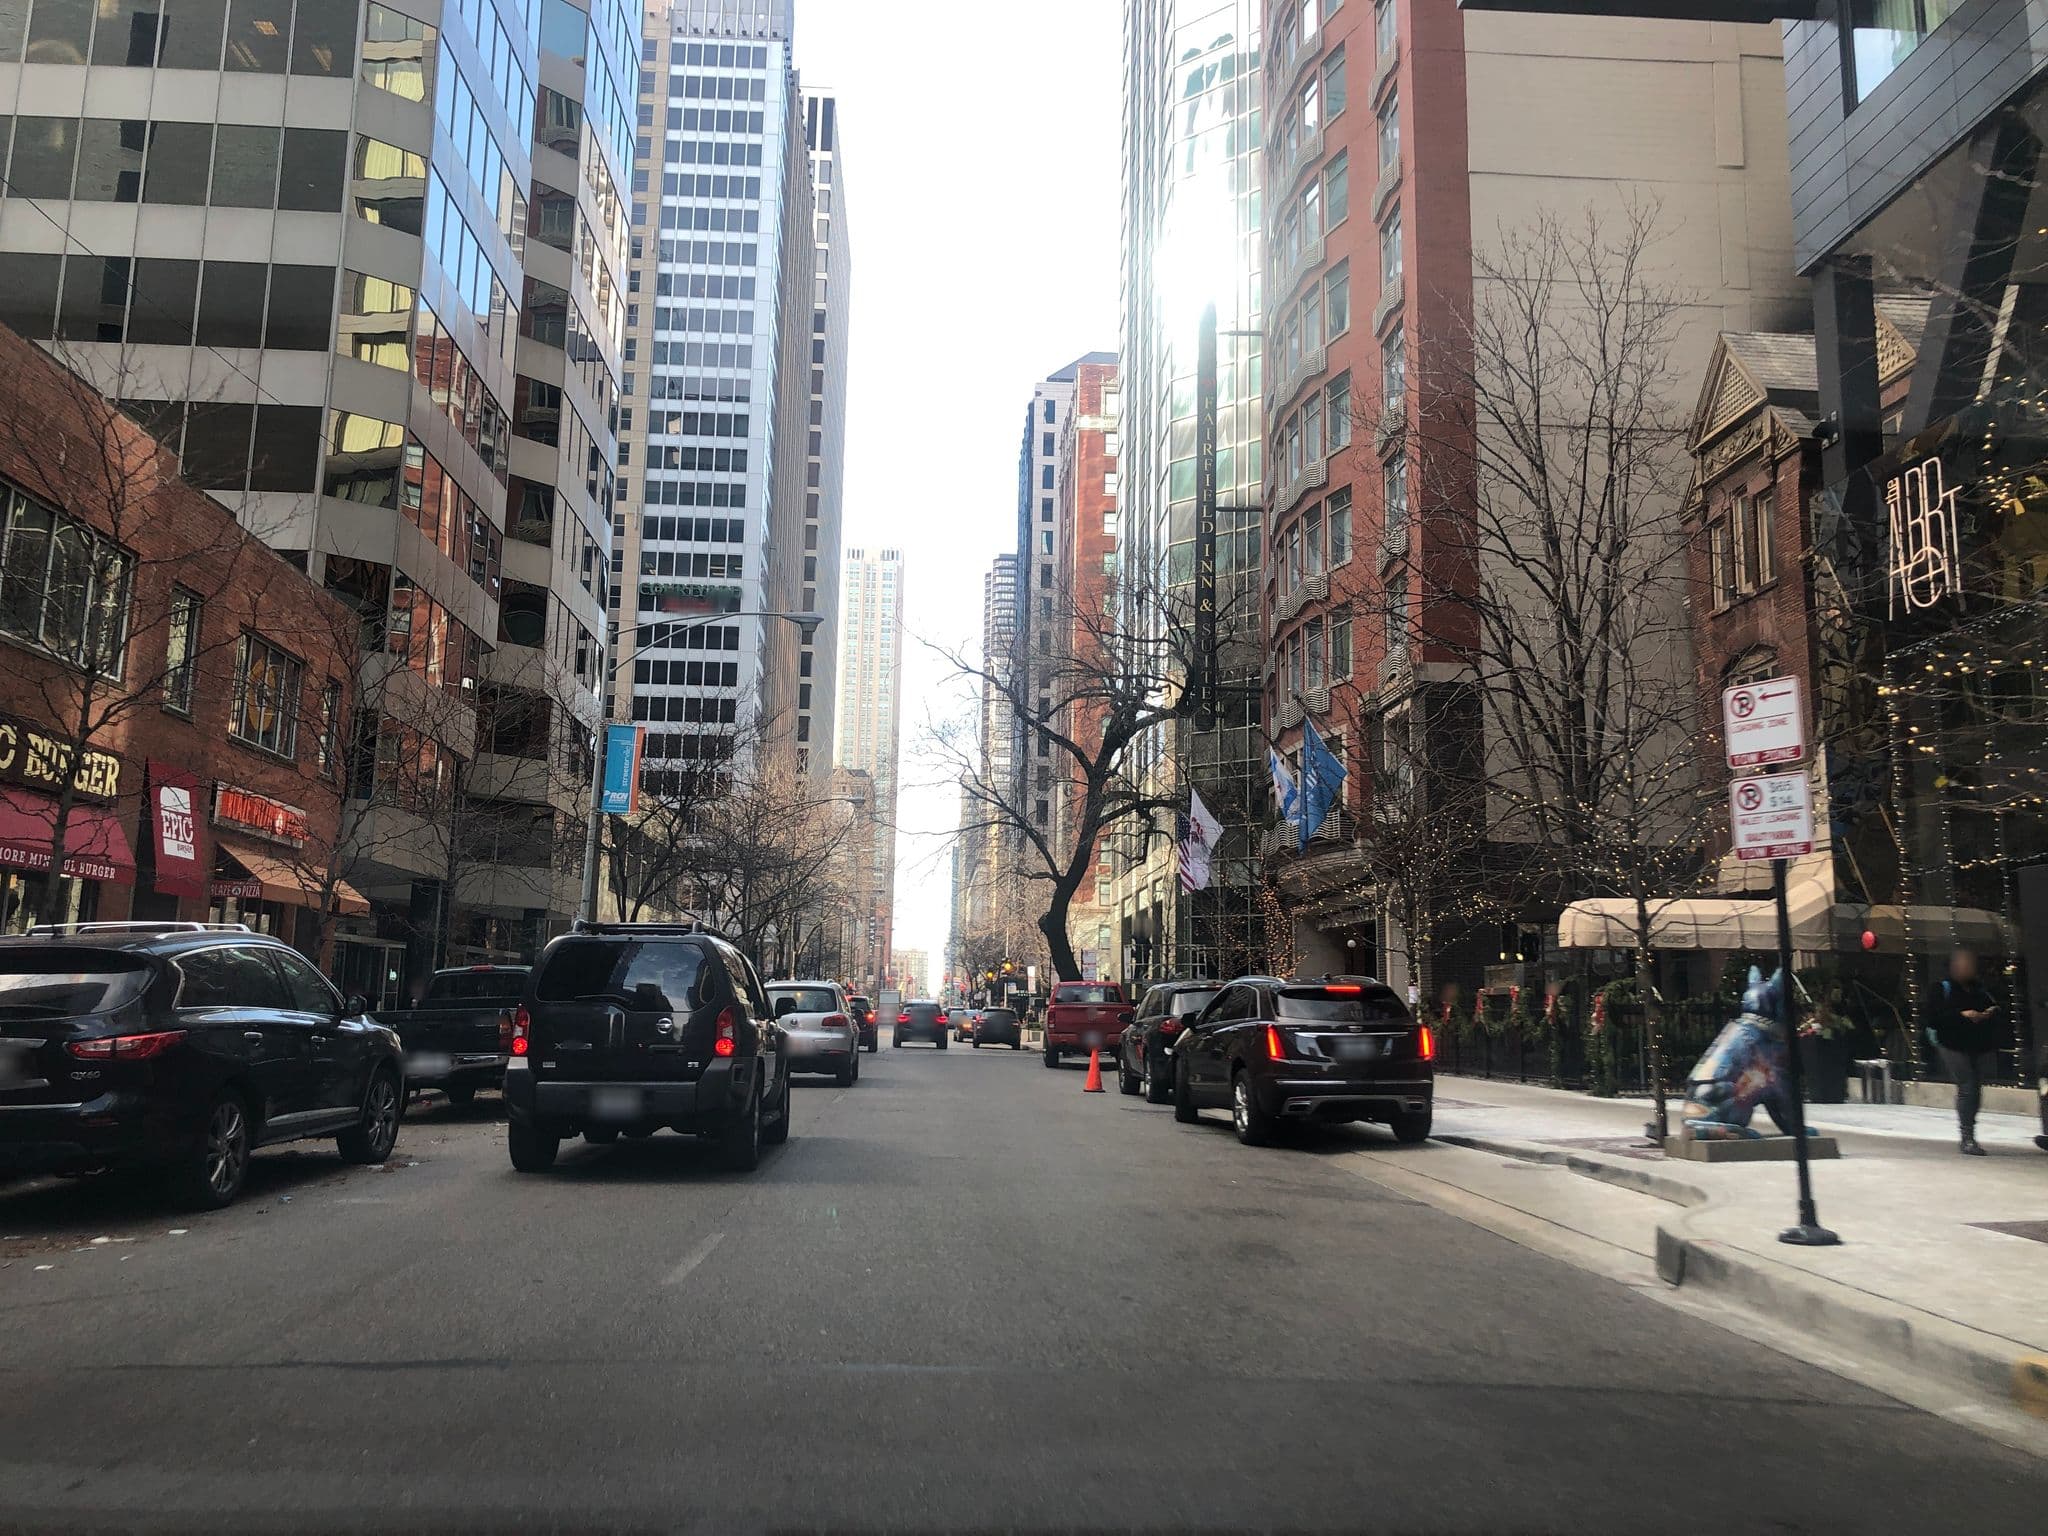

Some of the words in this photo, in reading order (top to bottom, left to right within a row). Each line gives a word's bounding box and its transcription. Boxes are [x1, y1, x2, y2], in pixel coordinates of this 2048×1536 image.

[1200, 396, 1215, 535] FAIRFIELD
[1200, 543, 1214, 589] INN
[1200, 598, 1213, 612] &
[1200, 623, 1213, 716] SUITES
[1733, 752, 1759, 766] TOW
[1762, 747, 1796, 762] ZONE
[161, 812, 194, 843] EPIC
[1740, 847, 1766, 859] TOW
[1769, 842, 1806, 856] ZONE
[28, 854, 76, 872] MINUL
[79, 862, 116, 879] BURGER
[210, 883, 231, 897] BLAZE
[242, 885, 261, 897] PIZZA
